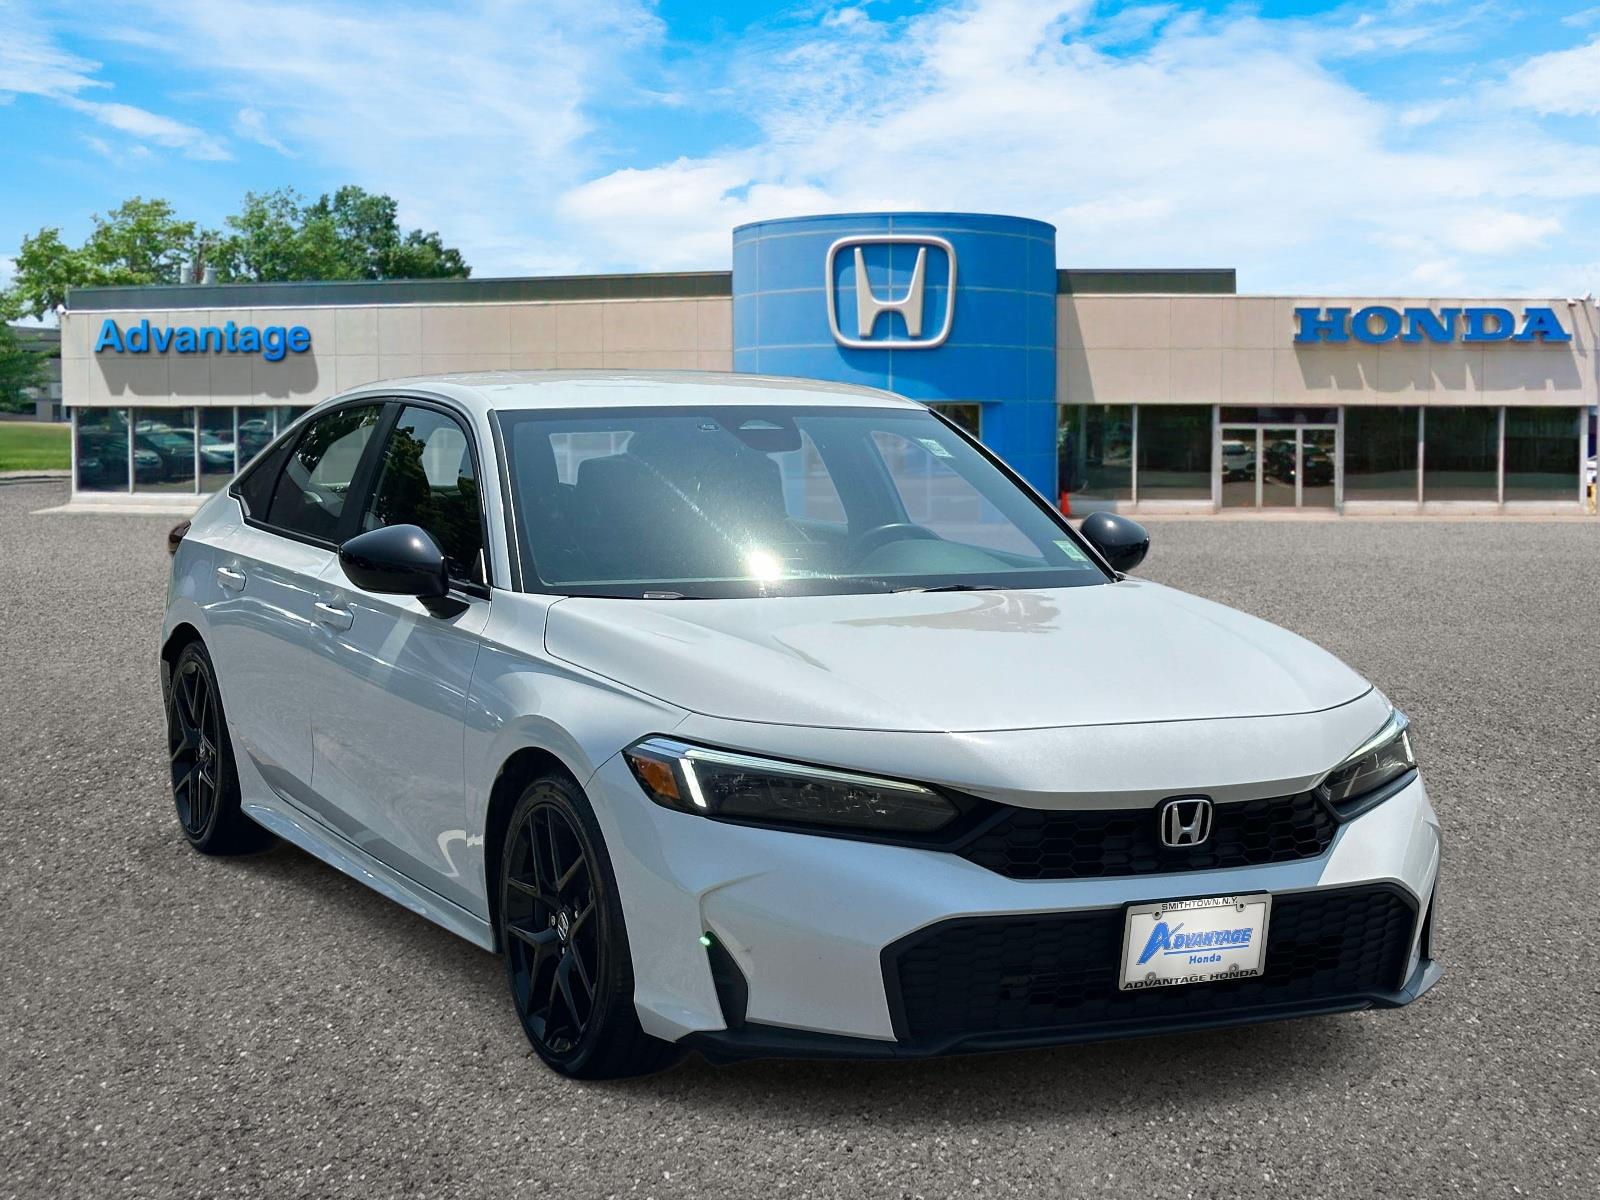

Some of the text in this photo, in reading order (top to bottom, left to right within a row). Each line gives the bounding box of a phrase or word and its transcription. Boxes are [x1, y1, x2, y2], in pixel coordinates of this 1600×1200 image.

[1294, 306, 1572, 344] HONDA
[95, 319, 311, 361] Advantage
[1188, 954, 1222, 965] Honda
[1123, 969, 1259, 990] ADVANTAGE HONDA
